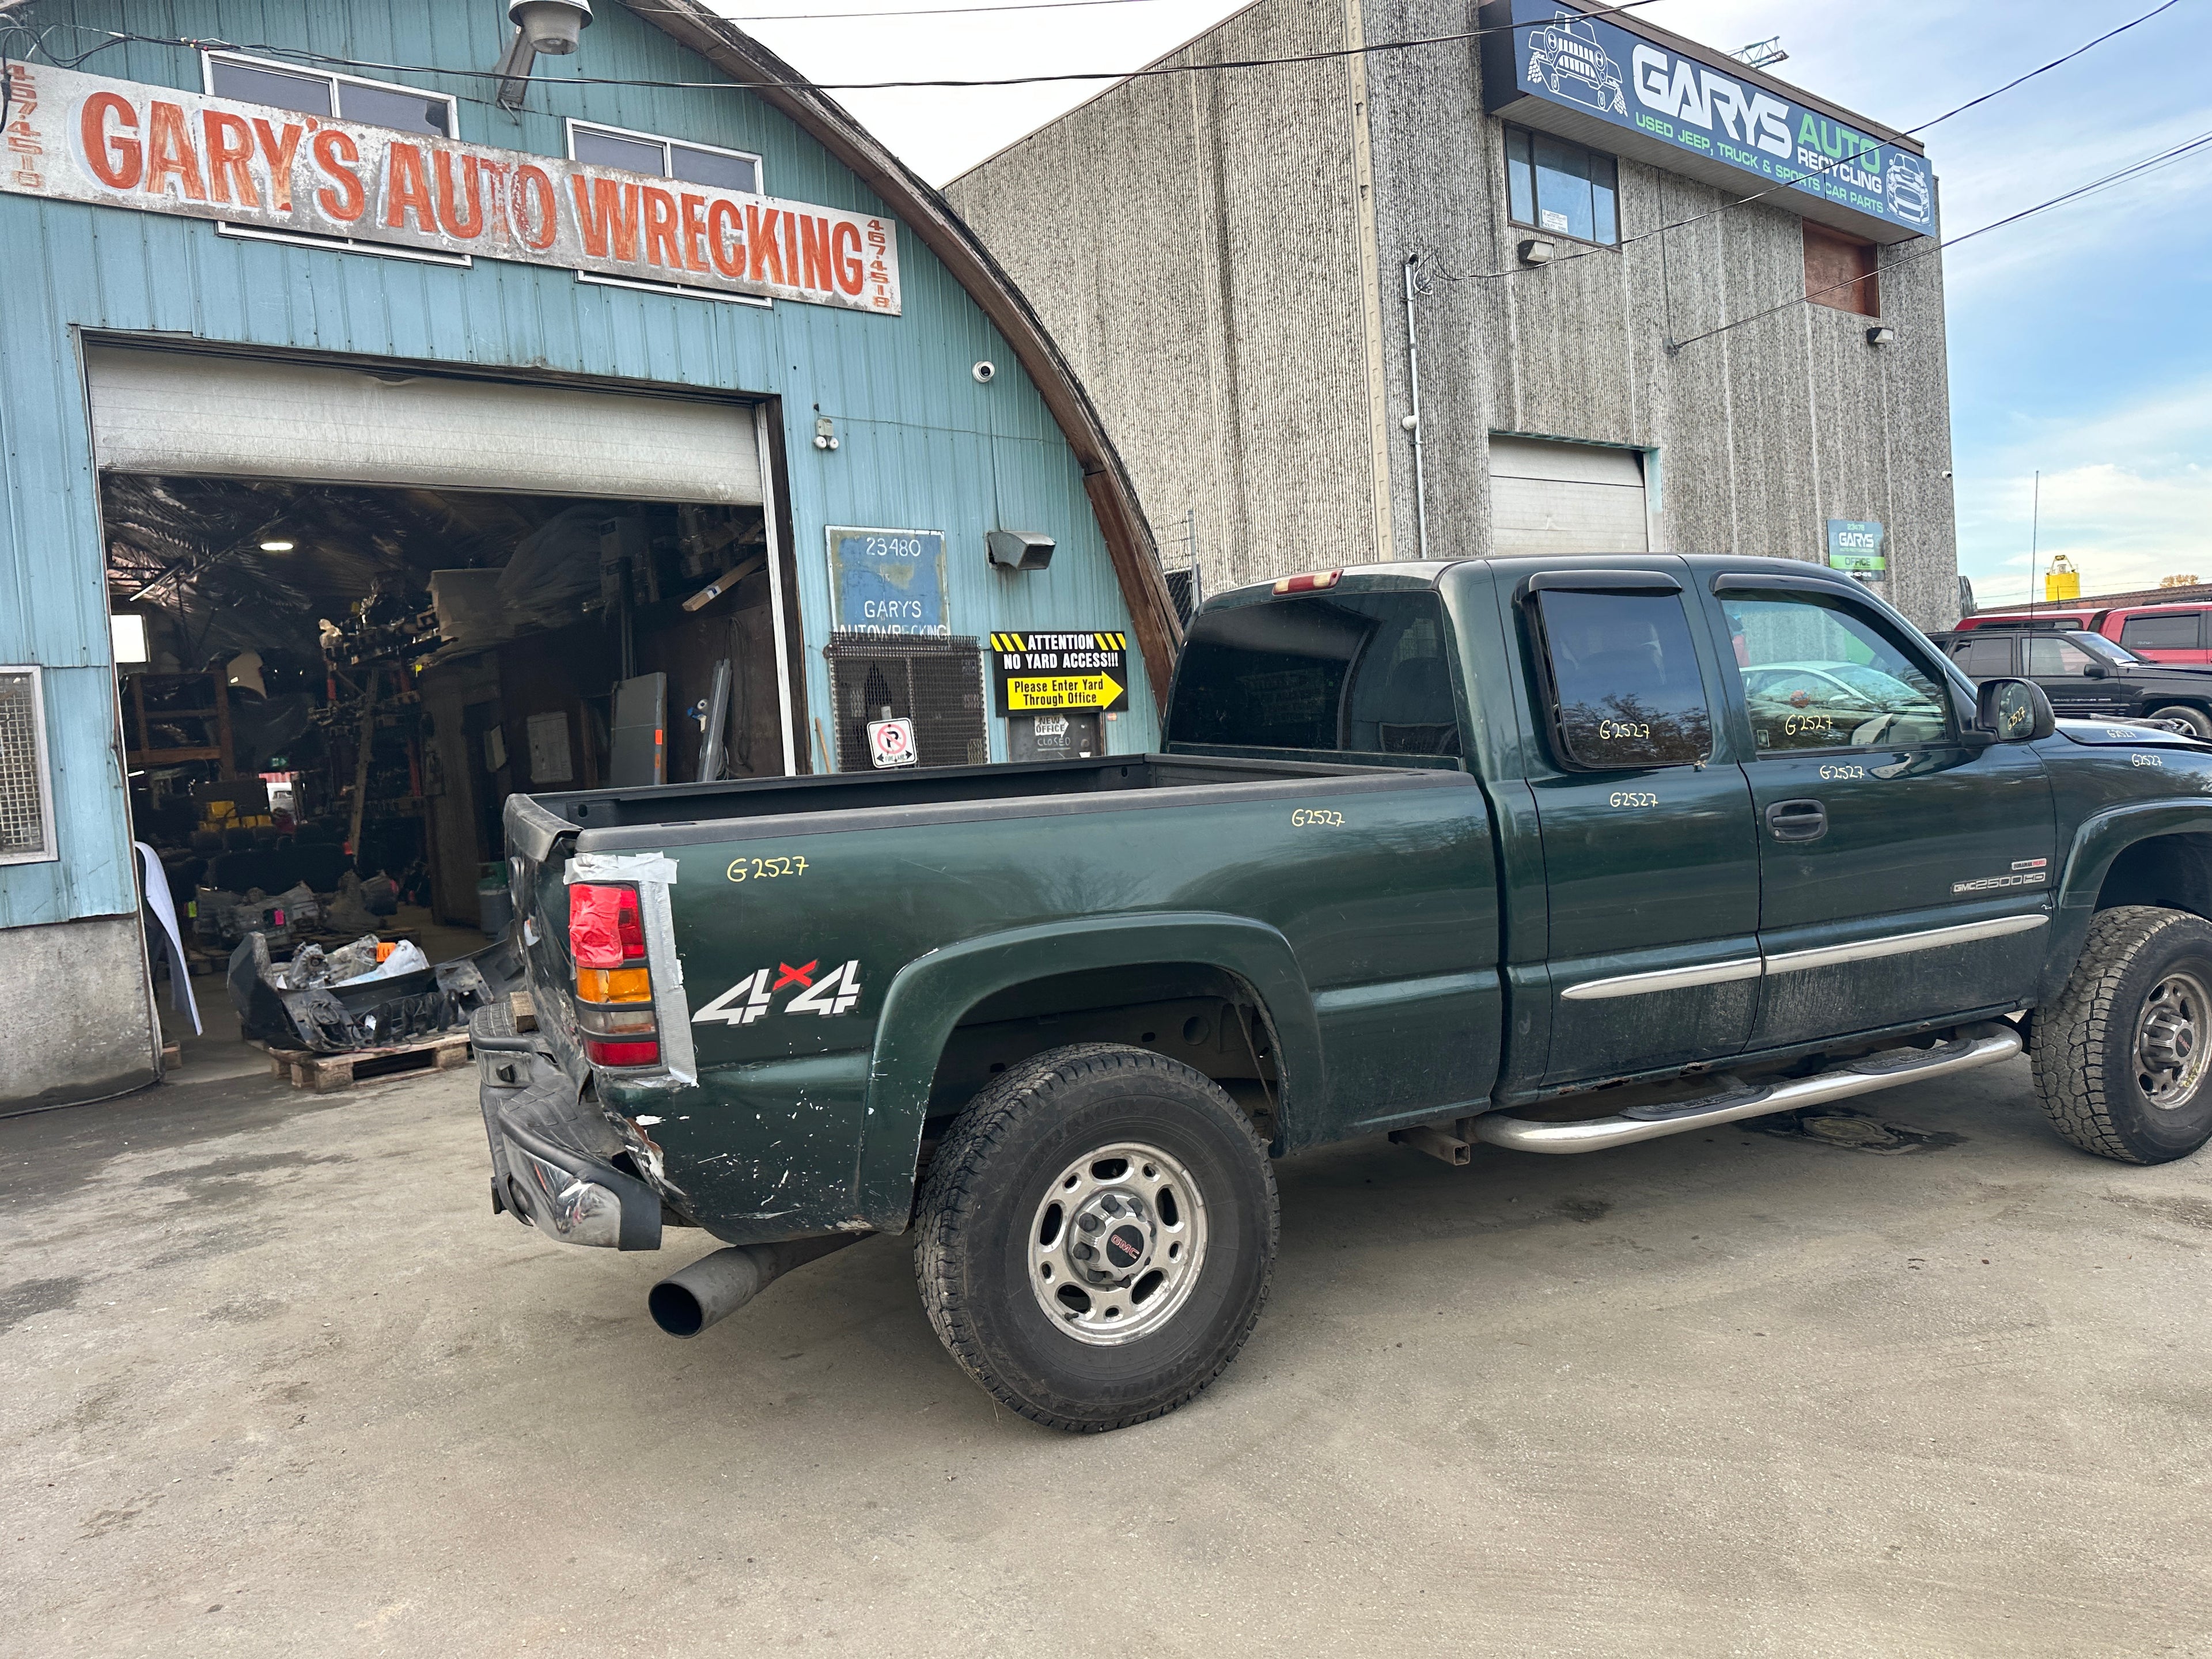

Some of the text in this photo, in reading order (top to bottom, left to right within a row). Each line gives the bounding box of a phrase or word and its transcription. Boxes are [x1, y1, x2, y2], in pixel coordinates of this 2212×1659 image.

[1633, 44, 1792, 159] GARYS
[1797, 112, 1881, 175] AUTO
[1635, 111, 1884, 214] USED JEEP, TRUCK & SPORTS CAR PARTS
[1797, 146, 1883, 195] RECYCLING
[80, 90, 863, 296] GARY'S AUTO WRECKING
[866, 537, 921, 557] 23480
[1838, 532, 1874, 548] GARYS
[1844, 556, 1871, 566] OFFICE
[864, 600, 922, 618] GARY'S
[1028, 634, 1094, 650] ATTENTION
[1003, 652, 1119, 670] NO YARD ACCESS!!!
[1014, 679, 1104, 693] Please Enter Yard
[1023, 692, 1097, 707] Through Office
[1036, 724, 1066, 733] OFFICE
[1039, 717, 1060, 725] NEW
[1600, 719, 1650, 740] G2527
[1785, 714, 1834, 736] G2527
[1037, 737, 1071, 747] CLOSED
[2131, 753, 2163, 767] G2527
[1819, 765, 1865, 780] G2527
[1609, 792, 1659, 808] G2527
[1291, 808, 1346, 827] G2527
[726, 855, 809, 882] G2527
[1111, 1234, 1140, 1260] GMC
